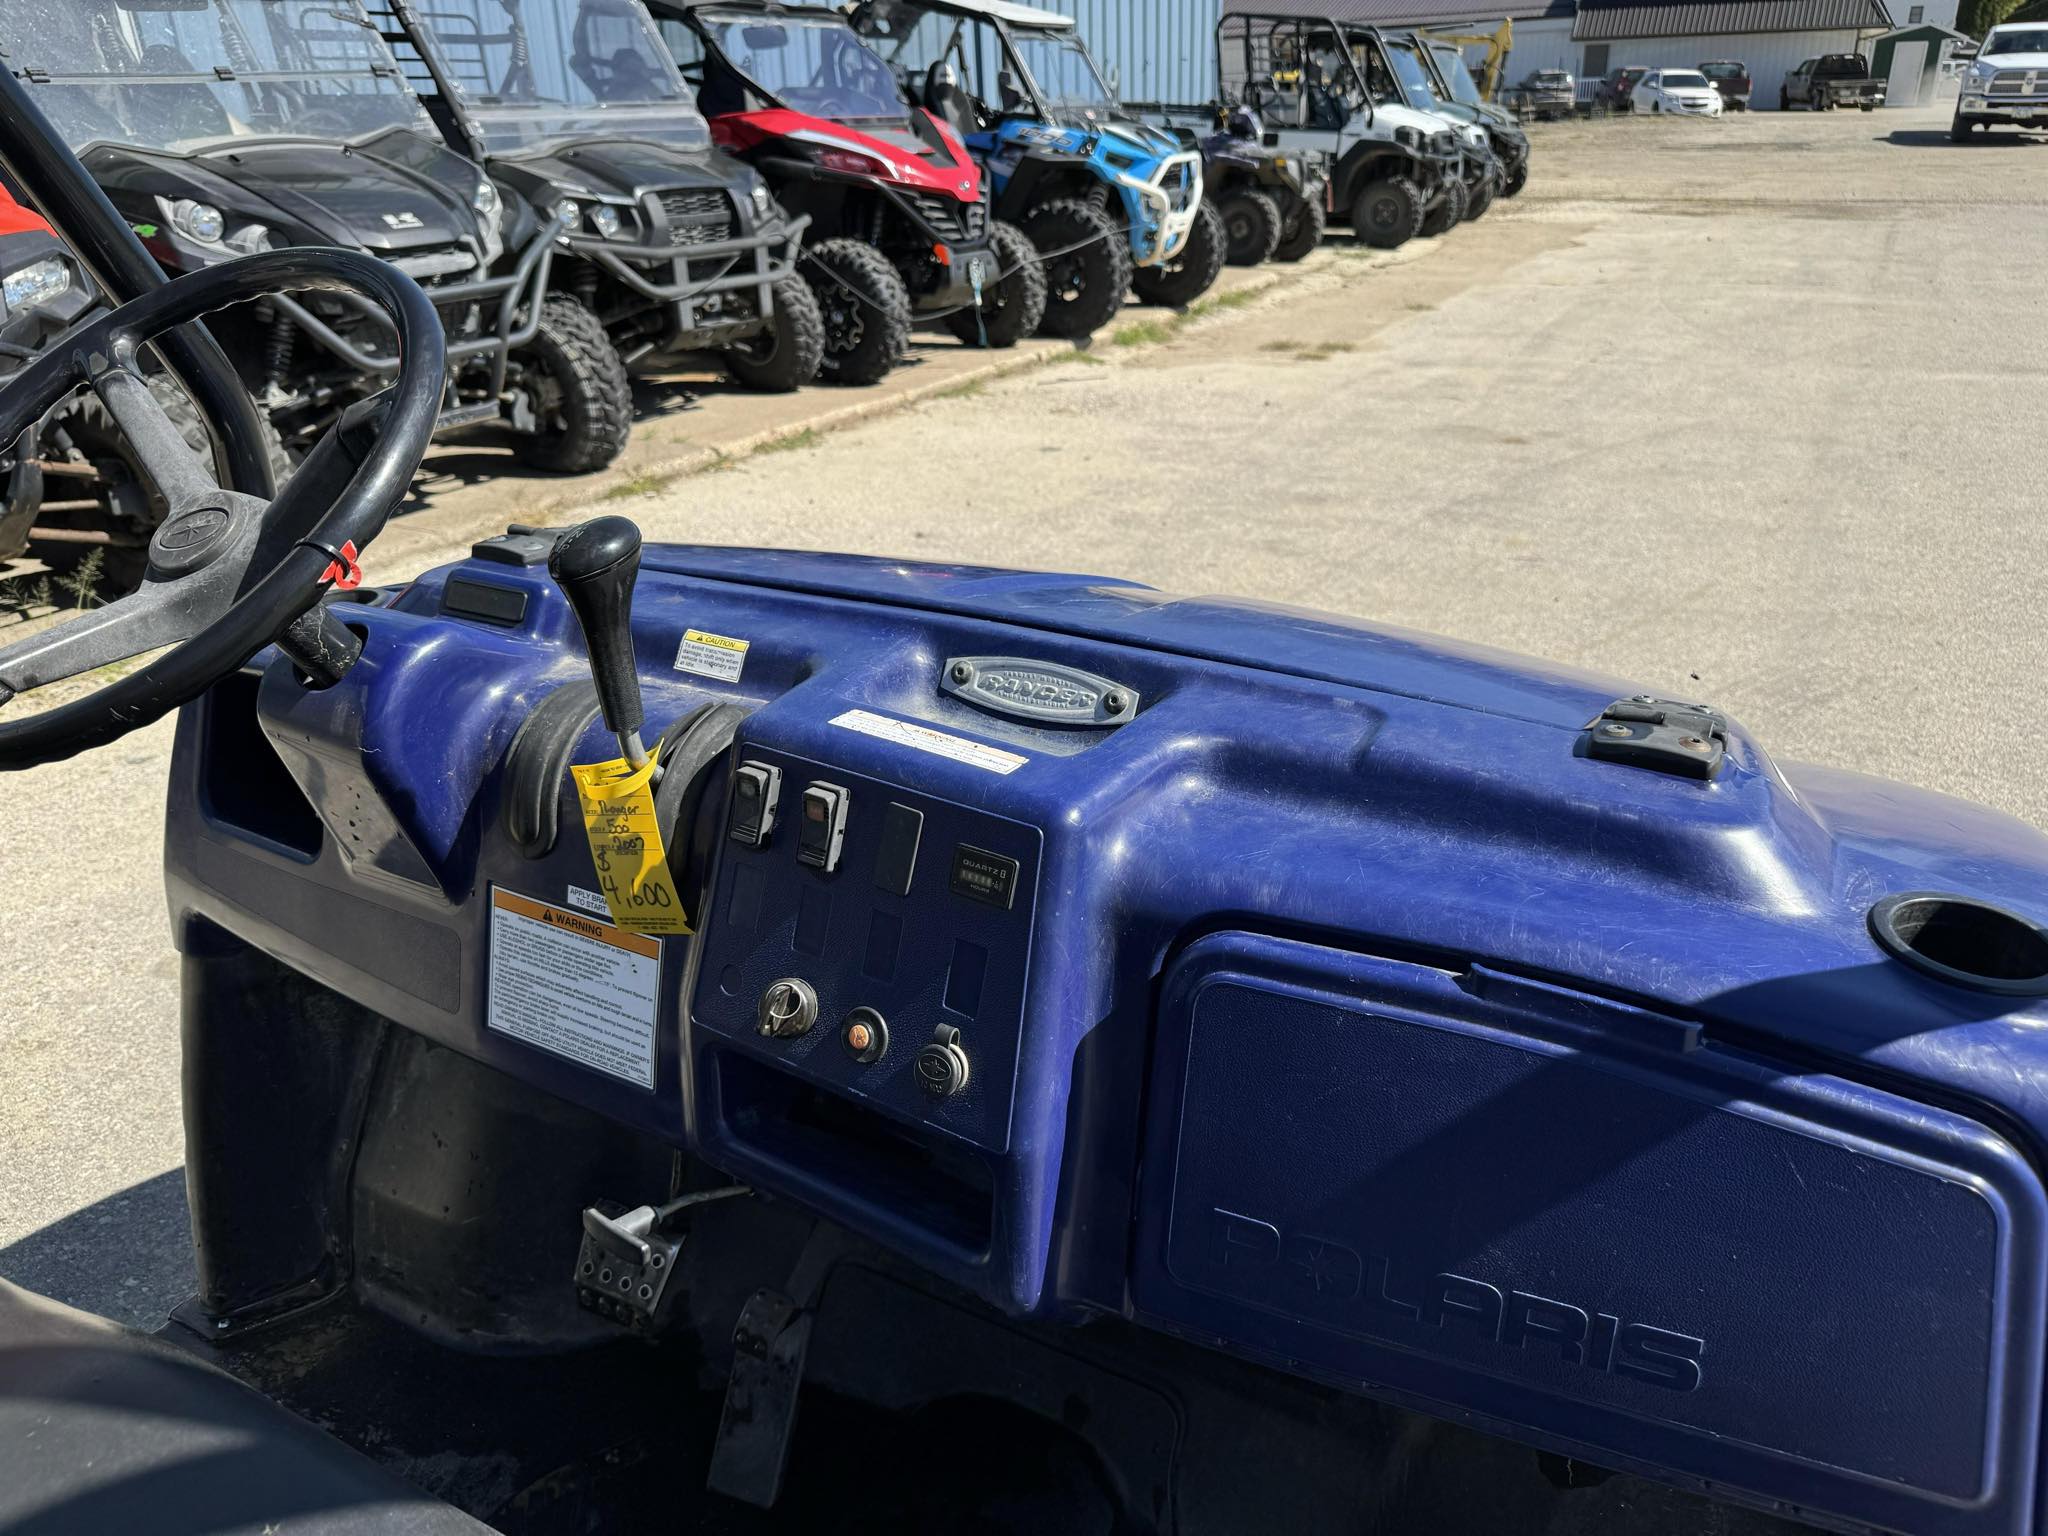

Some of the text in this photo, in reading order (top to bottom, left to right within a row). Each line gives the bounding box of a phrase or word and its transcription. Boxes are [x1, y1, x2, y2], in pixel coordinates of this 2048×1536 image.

[705, 636, 736, 648] CAUTION
[977, 673, 1098, 708] RANGER
[606, 818, 630, 834] 500
[962, 859, 999, 875] QUARTZ
[570, 888, 608, 905] APPLY BRA
[576, 897, 607, 912] TO START
[555, 912, 603, 938] WARNING
[1207, 1206, 1705, 1393] POLARIS
